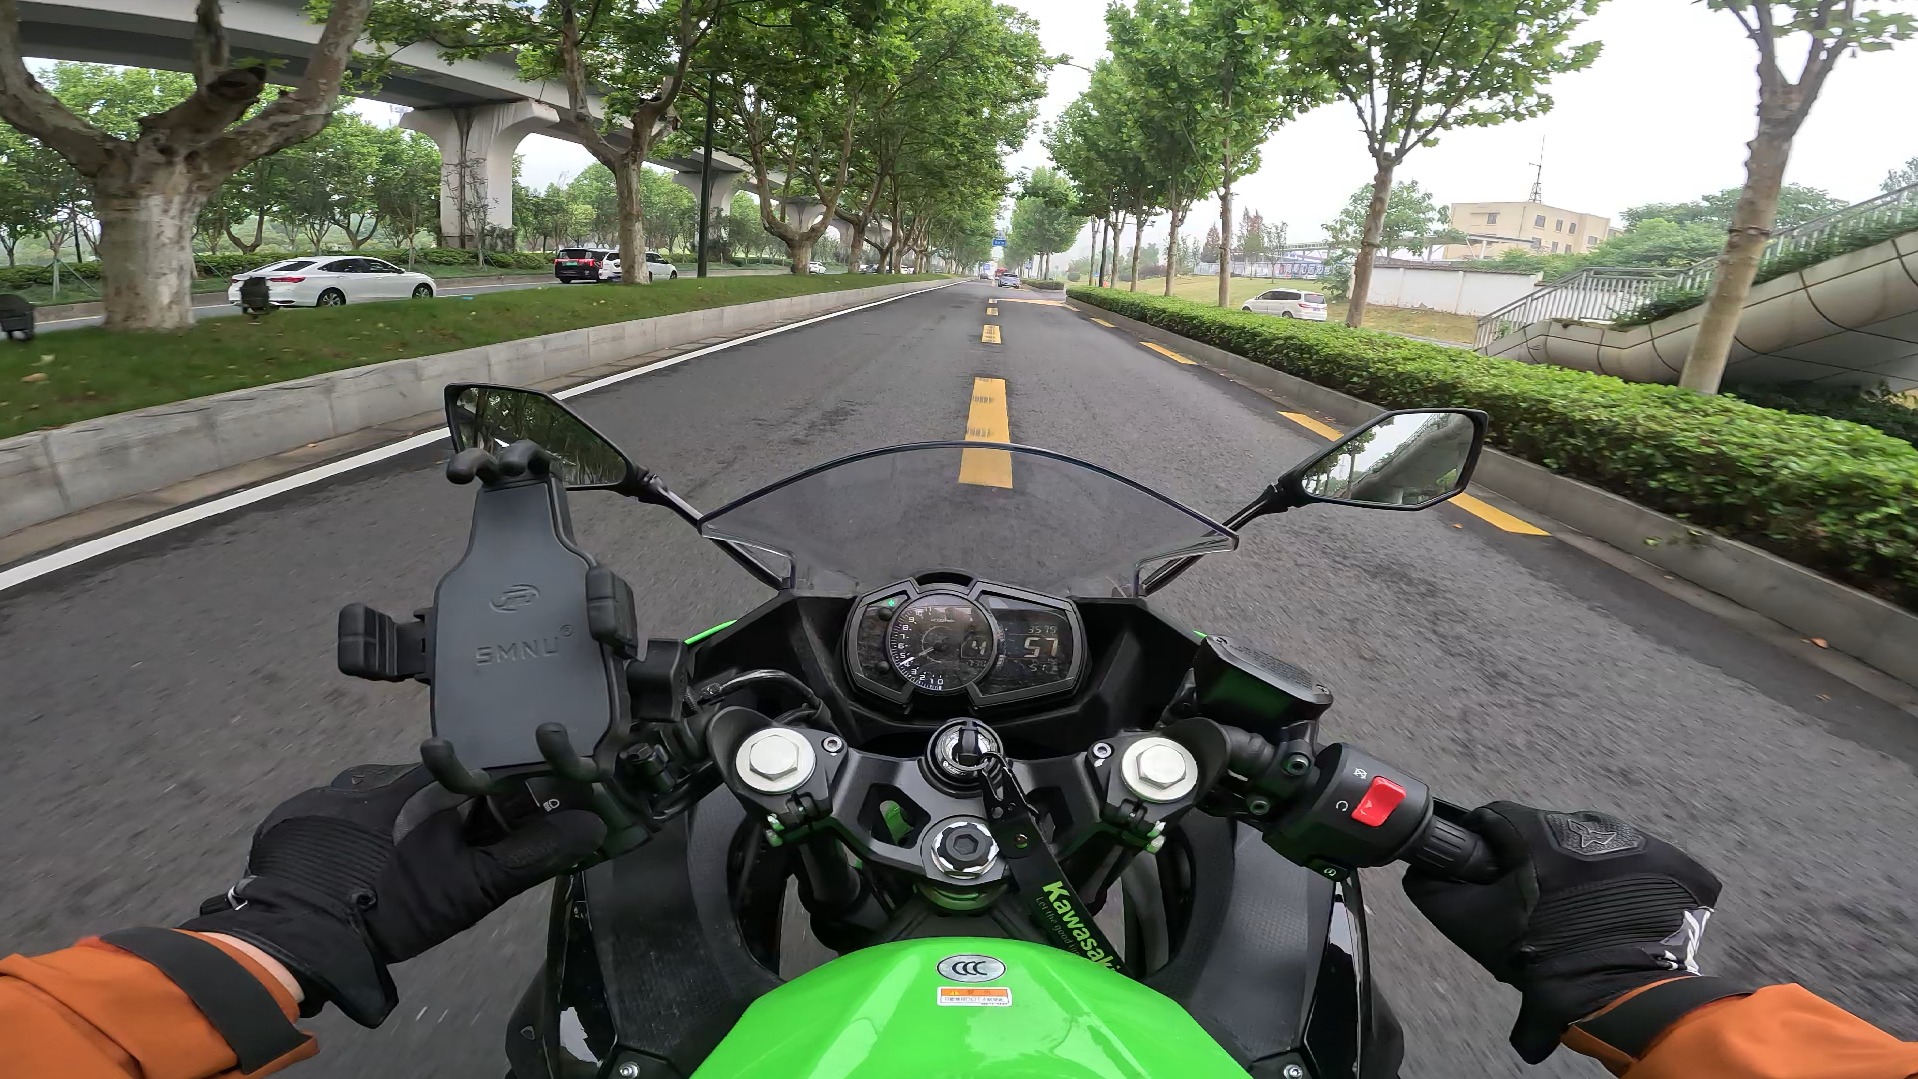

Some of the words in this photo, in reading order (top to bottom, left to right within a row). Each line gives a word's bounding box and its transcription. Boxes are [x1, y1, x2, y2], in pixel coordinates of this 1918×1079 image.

[1024, 637, 1059, 658] 57
[1043, 881, 1121, 970] Kawasak
[1052, 924, 1073, 944] good
[951, 960, 987, 976] CCC
